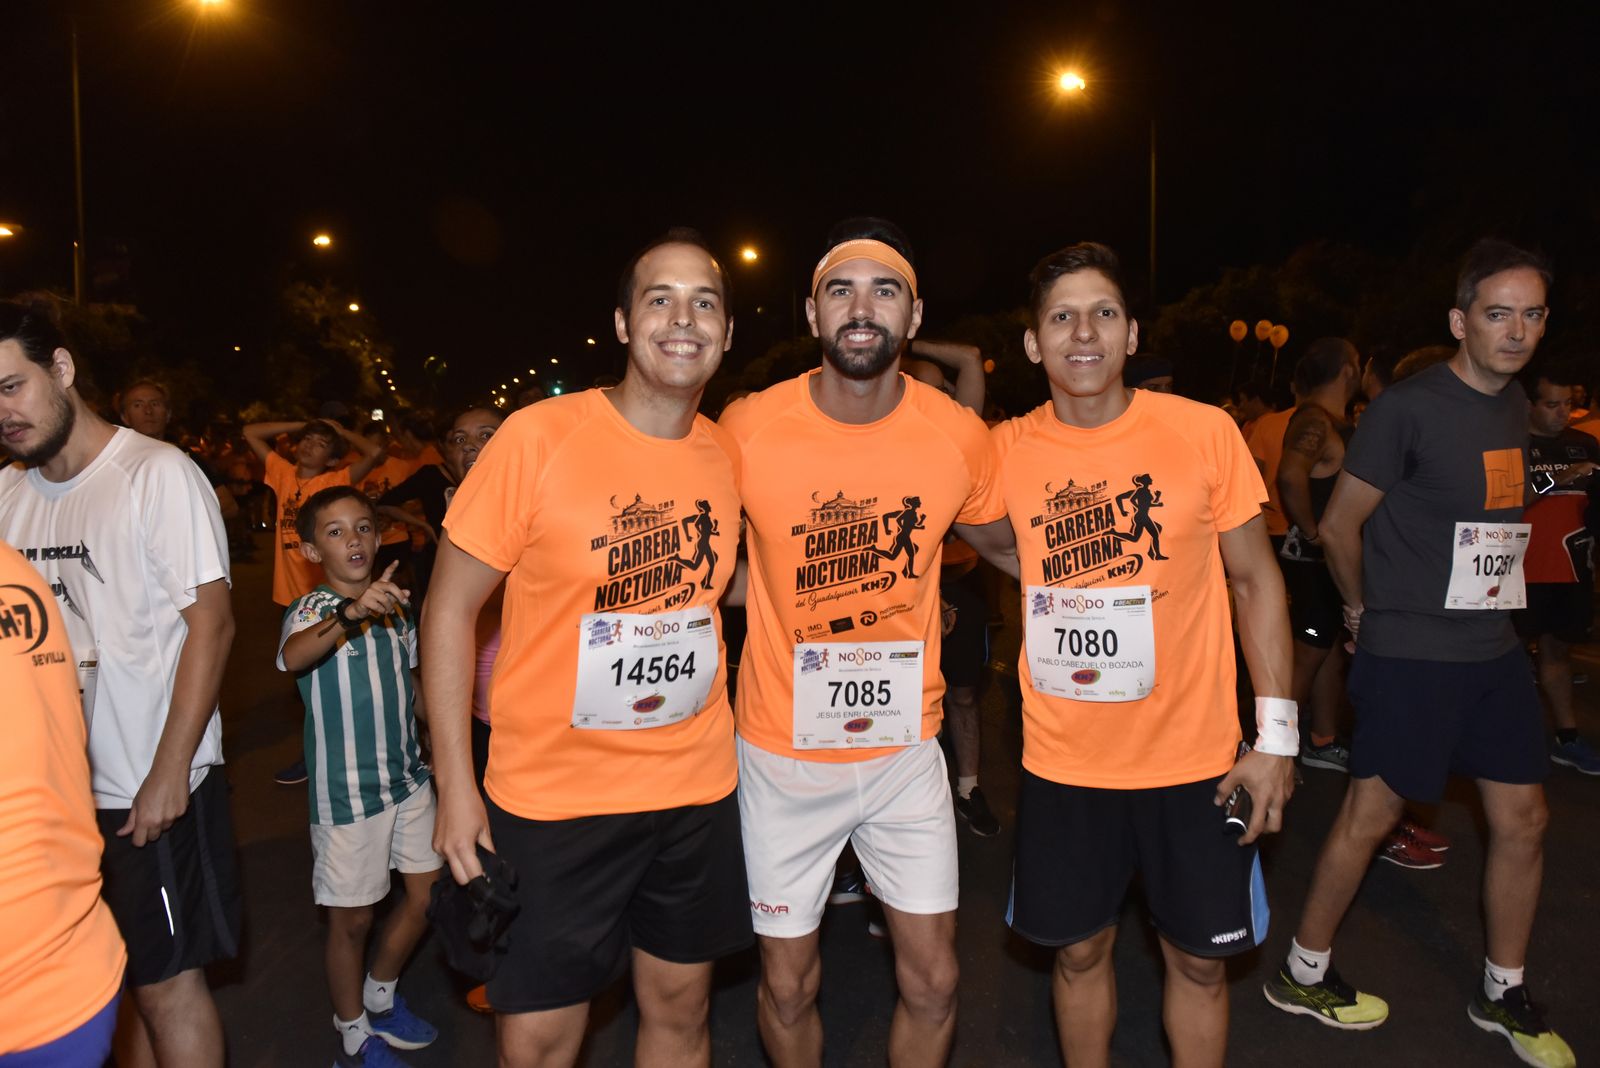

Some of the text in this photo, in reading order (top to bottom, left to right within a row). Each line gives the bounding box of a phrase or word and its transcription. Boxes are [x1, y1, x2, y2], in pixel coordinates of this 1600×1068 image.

[791, 524, 806, 536] XXXI
[1030, 515, 1044, 528] XXXI
[1044, 502, 1116, 549] CARRERA
[591, 535, 608, 552] XXXI
[608, 525, 681, 576] CARRERA
[805, 520, 879, 559] CARRERA
[1042, 535, 1124, 583] NOCTURNA
[796, 551, 880, 591] NOCTURNA
[594, 561, 684, 611] NOCTURNA
[795, 598, 805, 608] del
[807, 624, 822, 633] IMD
[1054, 627, 1118, 657] 7080
[32, 652, 66, 667] SEVILLA
[611, 651, 696, 686] 14564
[1037, 657, 1144, 669] PABLO CABEZUELO BOZADA
[828, 680, 891, 707] 7085
[816, 711, 841, 719] JESUS
[863, 709, 901, 718] CARMONA
[750, 901, 789, 914] VOVA
